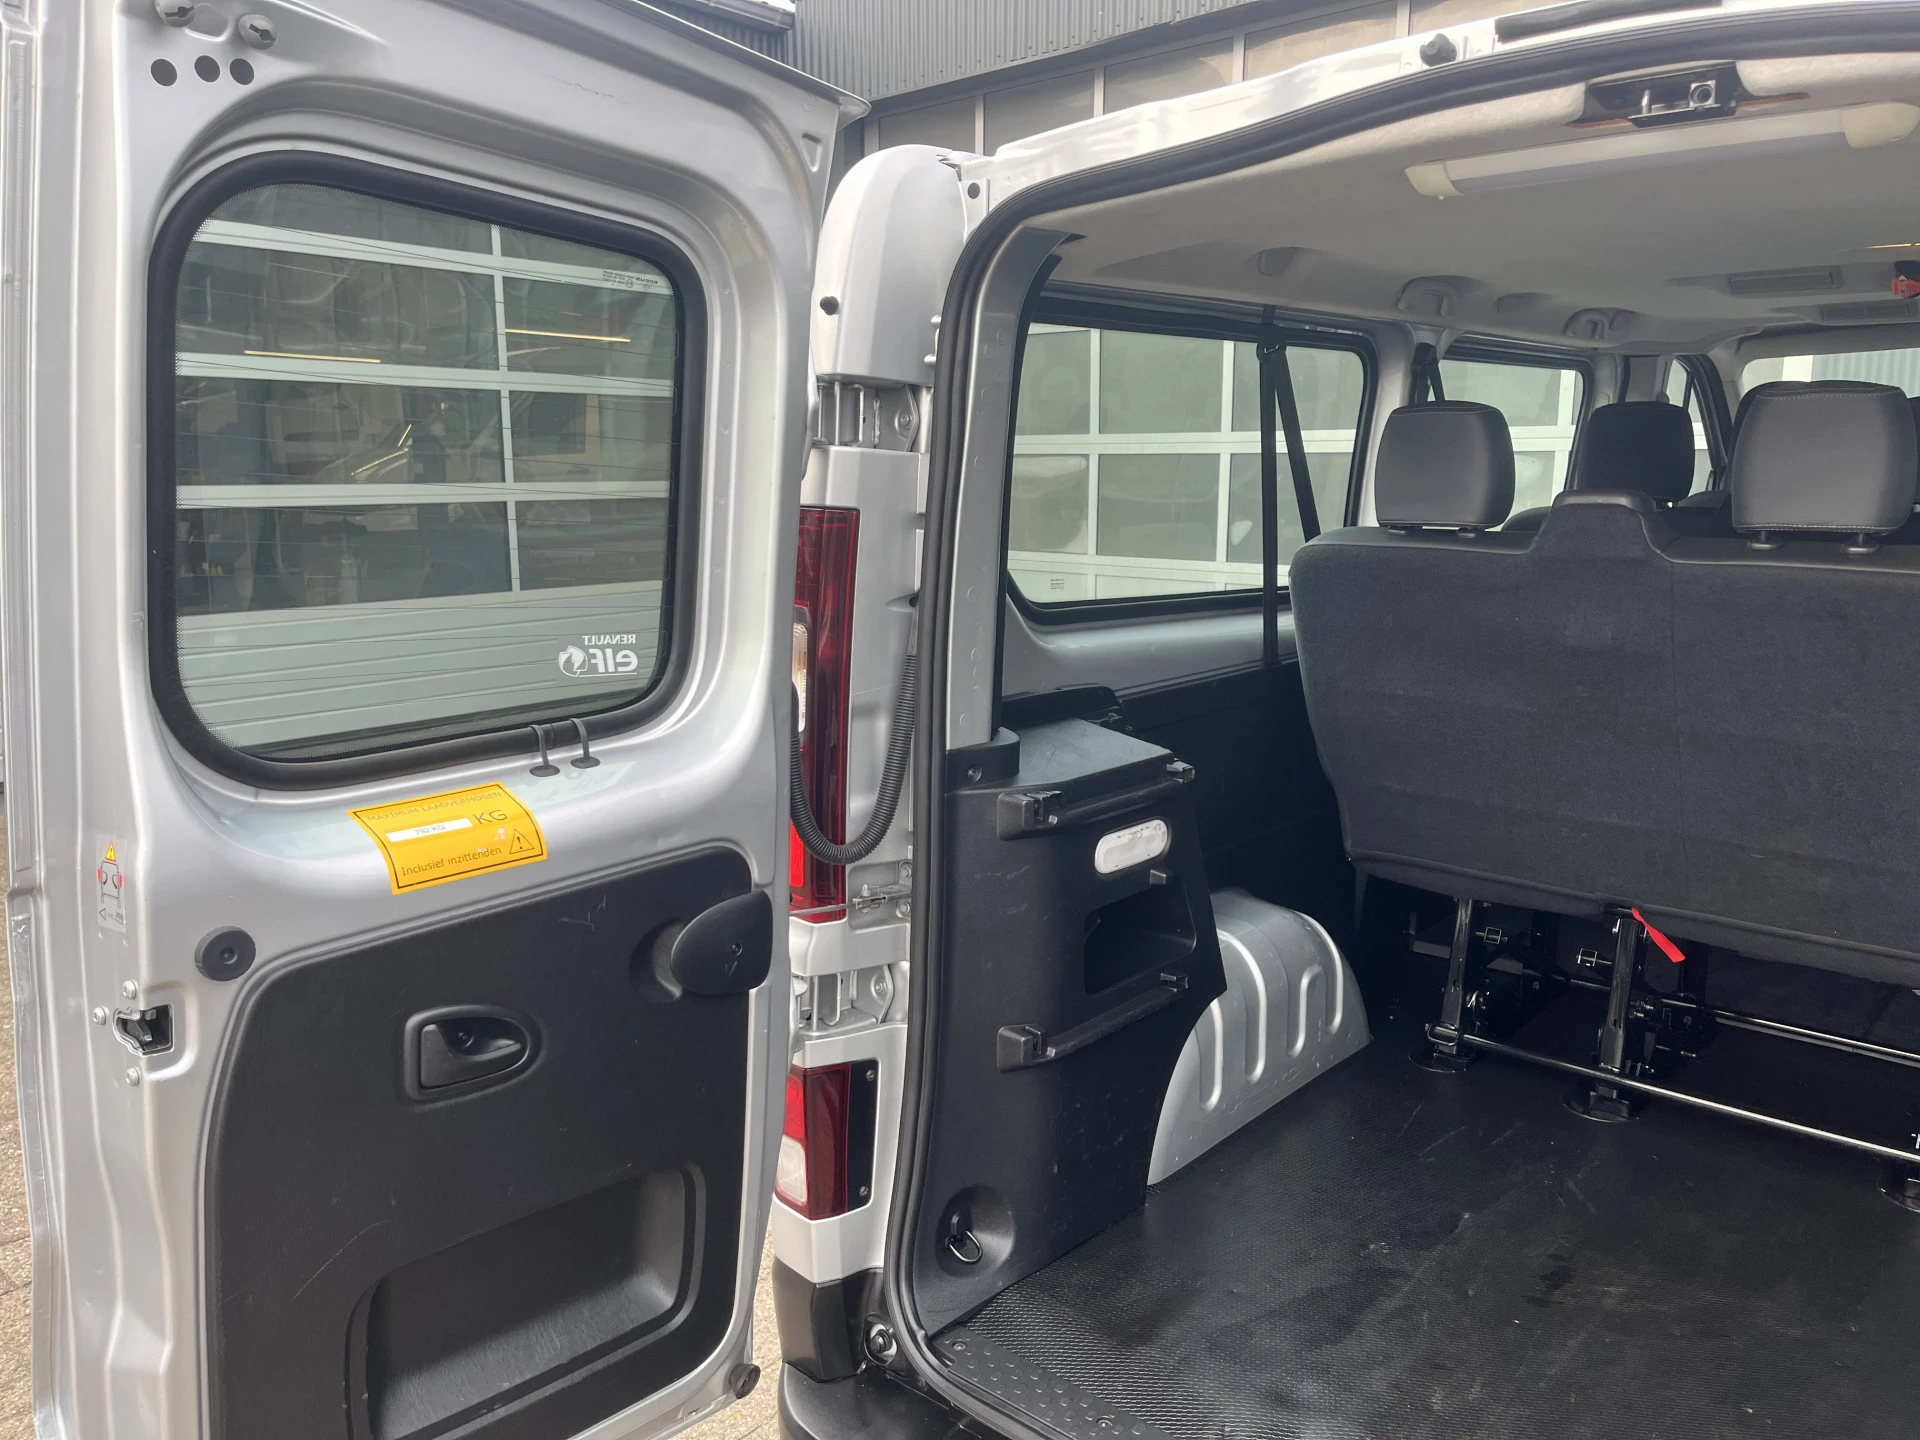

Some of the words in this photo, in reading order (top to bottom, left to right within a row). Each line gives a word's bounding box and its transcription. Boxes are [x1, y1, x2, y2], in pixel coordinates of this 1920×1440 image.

[367, 807, 420, 822] MAXIMUM
[421, 791, 502, 812] LAADVERMOGEN
[473, 809, 508, 825] KG
[414, 827, 430, 836] 792
[432, 824, 446, 832] KG
[401, 858, 445, 876] Inclusief
[447, 846, 502, 865] inzittenden
